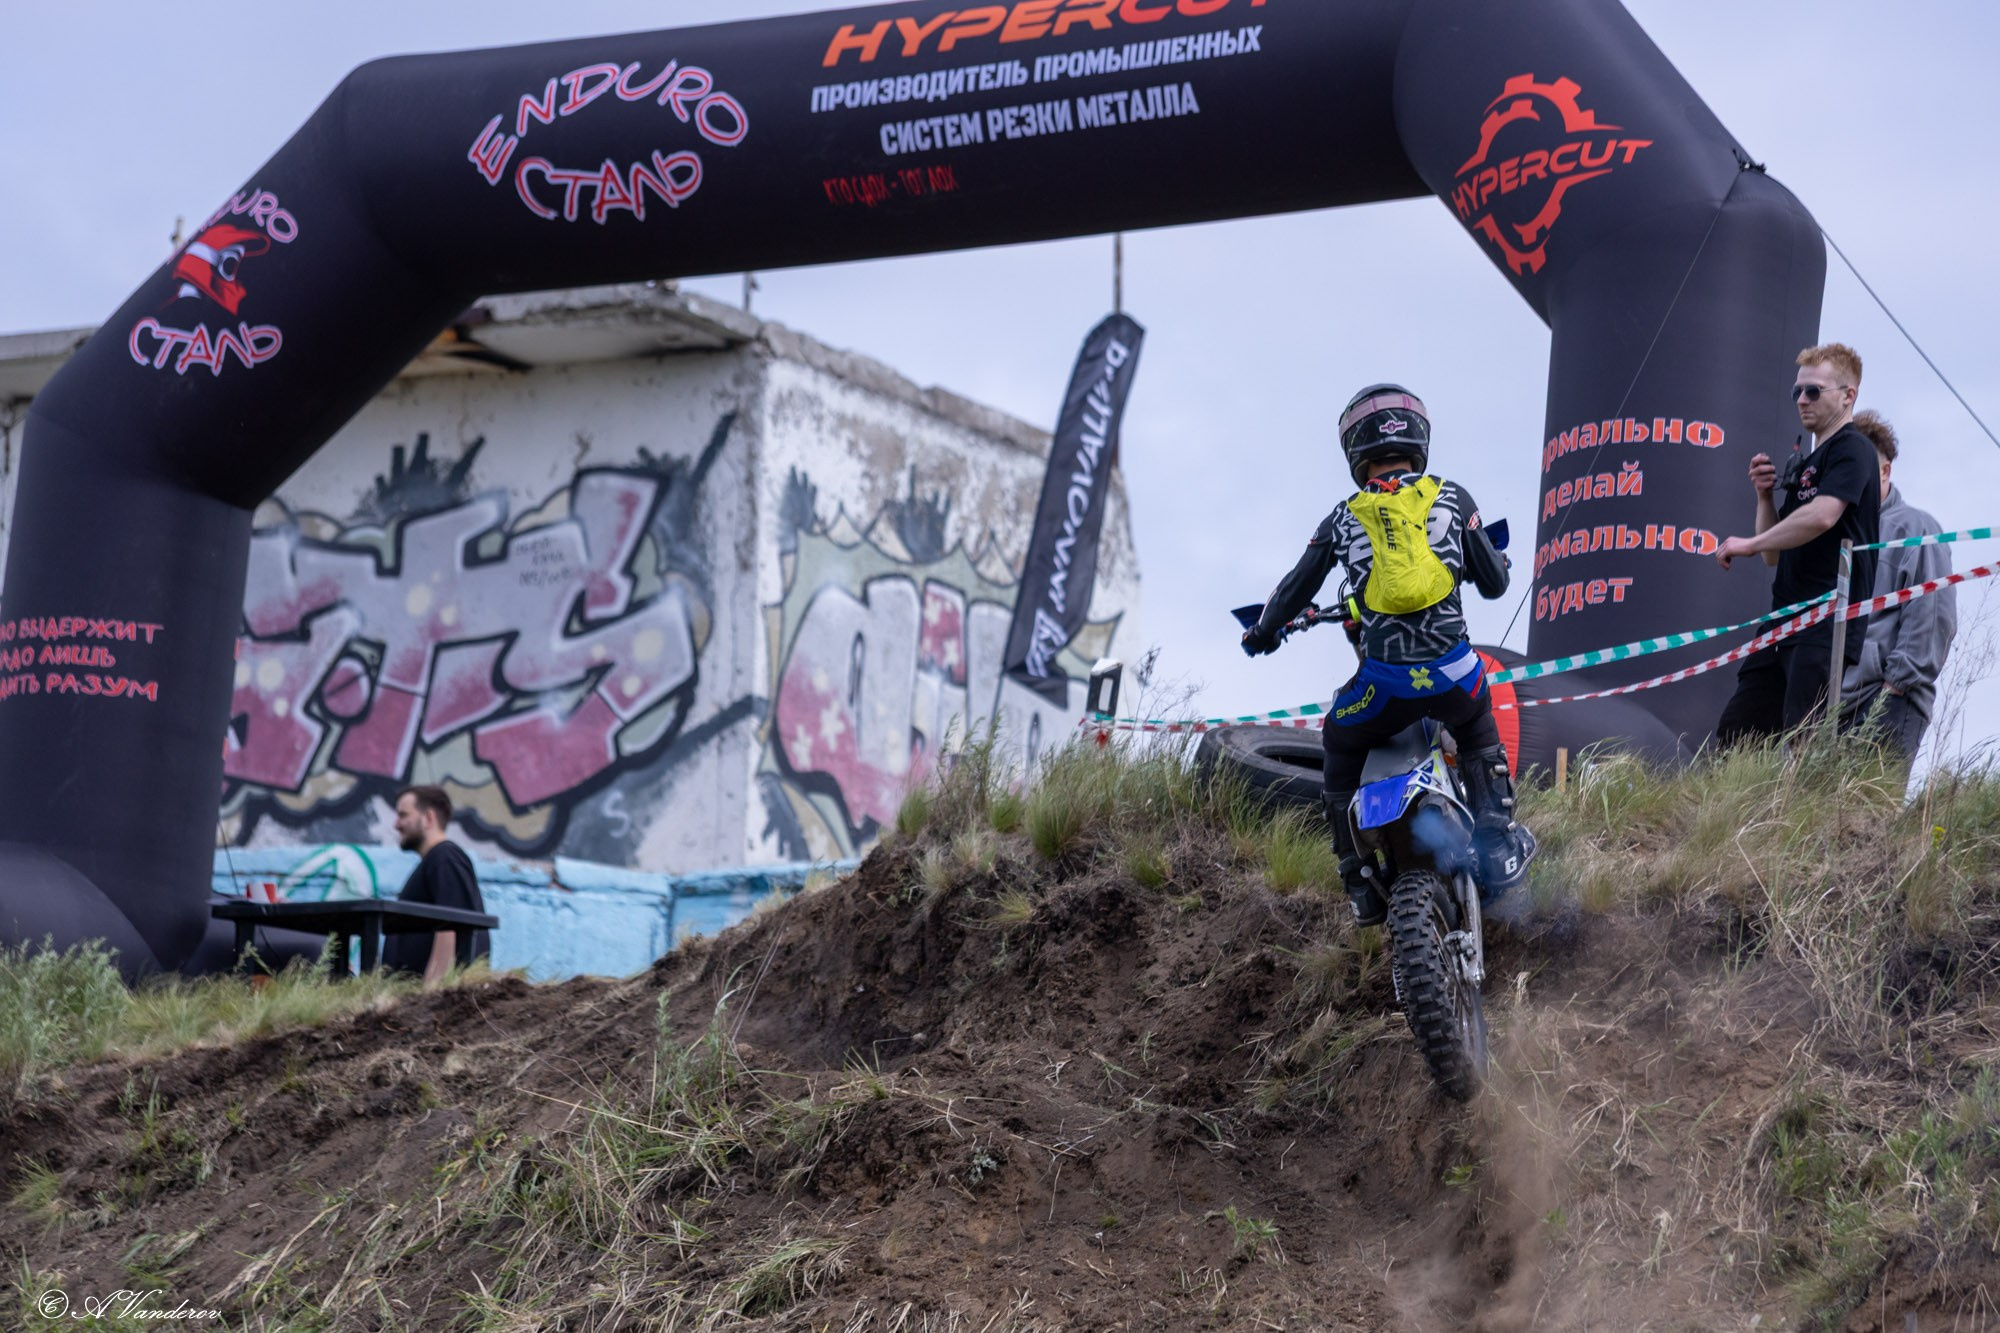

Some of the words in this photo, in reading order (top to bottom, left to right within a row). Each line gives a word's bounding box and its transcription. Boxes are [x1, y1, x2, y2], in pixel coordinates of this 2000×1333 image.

[822, 0, 1267, 67] HYPERC
[811, 61, 1028, 113] ПРОИЗВОДИТЕЛЬ
[1034, 25, 1262, 83] ПРОМЫШЛЕННЫХ
[468, 58, 749, 186] ENDURO
[880, 112, 983, 156] СИСТЕМ
[988, 100, 1073, 140] РЕЗКИ
[1077, 82, 1200, 131] МЕТАЛЛА
[1451, 139, 1653, 221] HYPERCUT
[1542, 460, 1644, 523] делай
[1378, 506, 1397, 551] USWE
[18, 616, 165, 645] ВЫДЕРЖИТ
[1535, 577, 1634, 622] будет
[38, 645, 116, 668] ЛИШЬ
[45, 673, 159, 702] РАЗУМ
